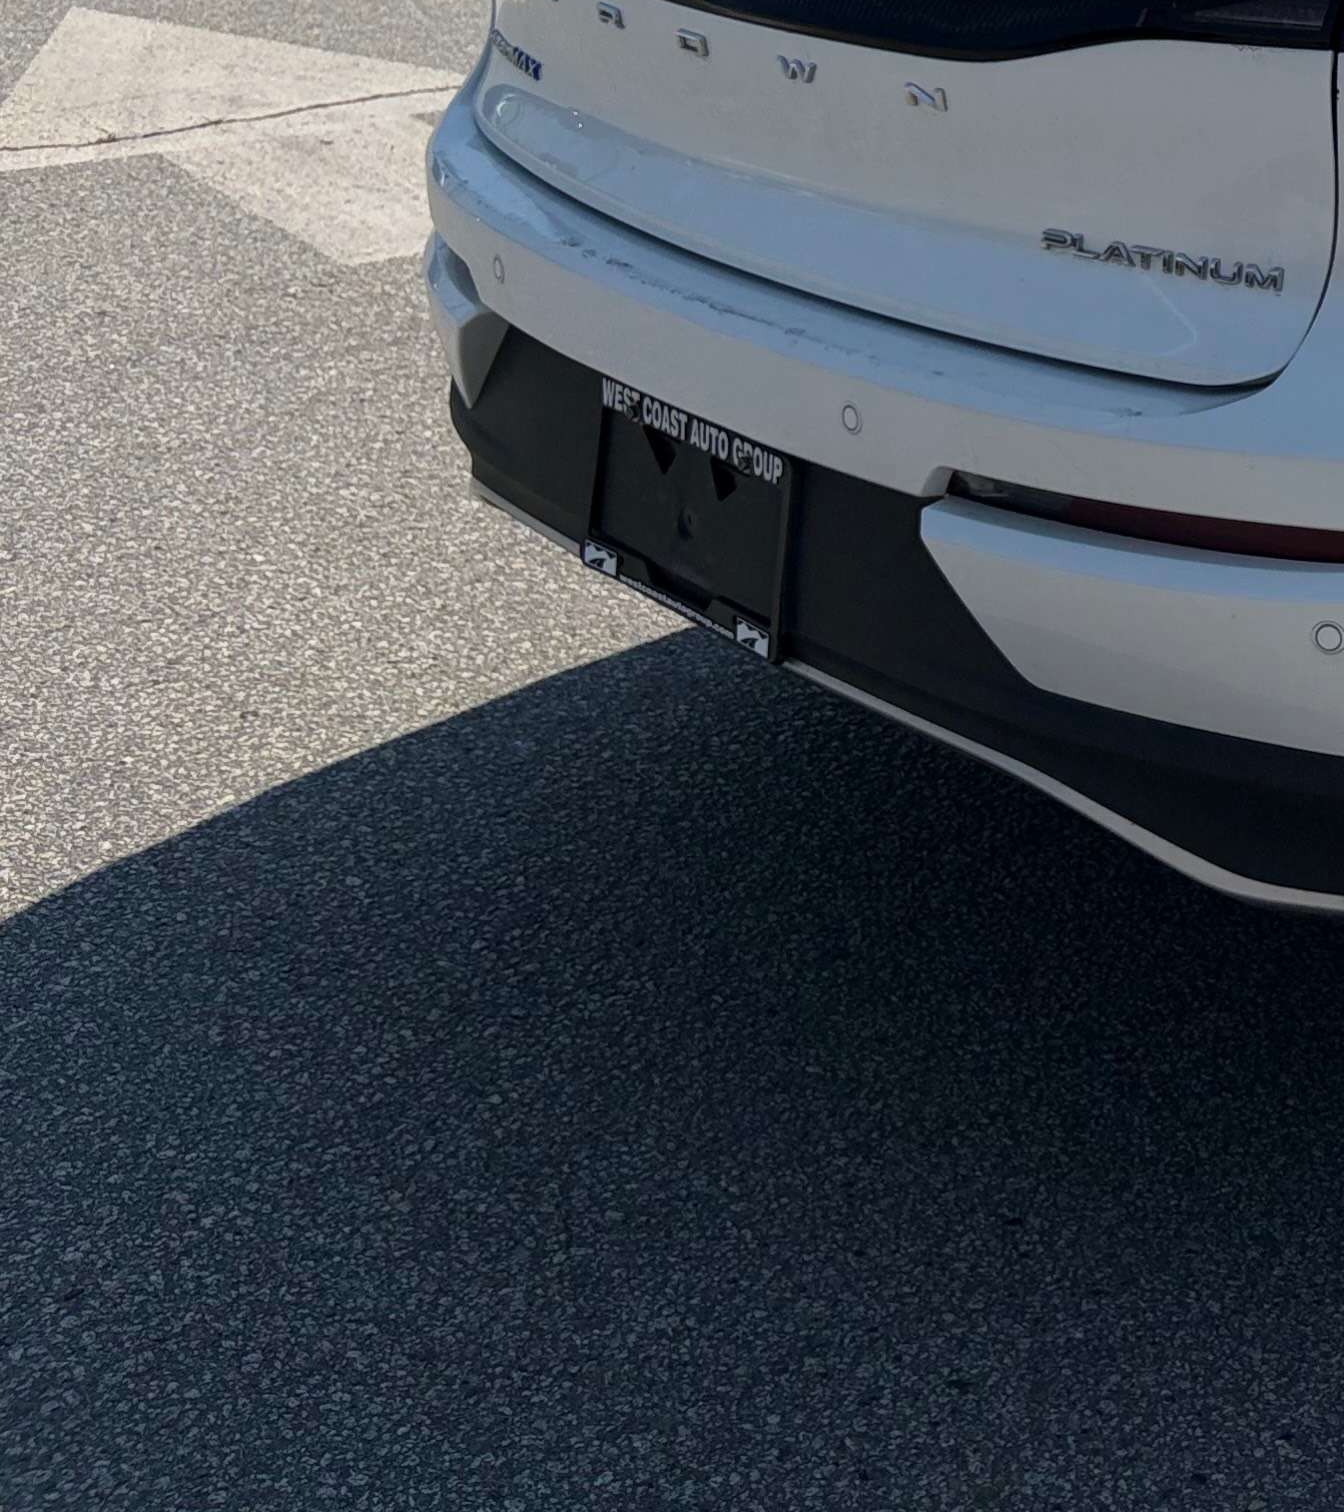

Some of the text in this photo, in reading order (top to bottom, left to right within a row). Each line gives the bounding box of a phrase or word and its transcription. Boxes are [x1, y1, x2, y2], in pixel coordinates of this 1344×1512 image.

[1040, 227, 1286, 292] PLATINUM
[642, 396, 688, 441] COAST
[690, 418, 729, 460] AUTO
